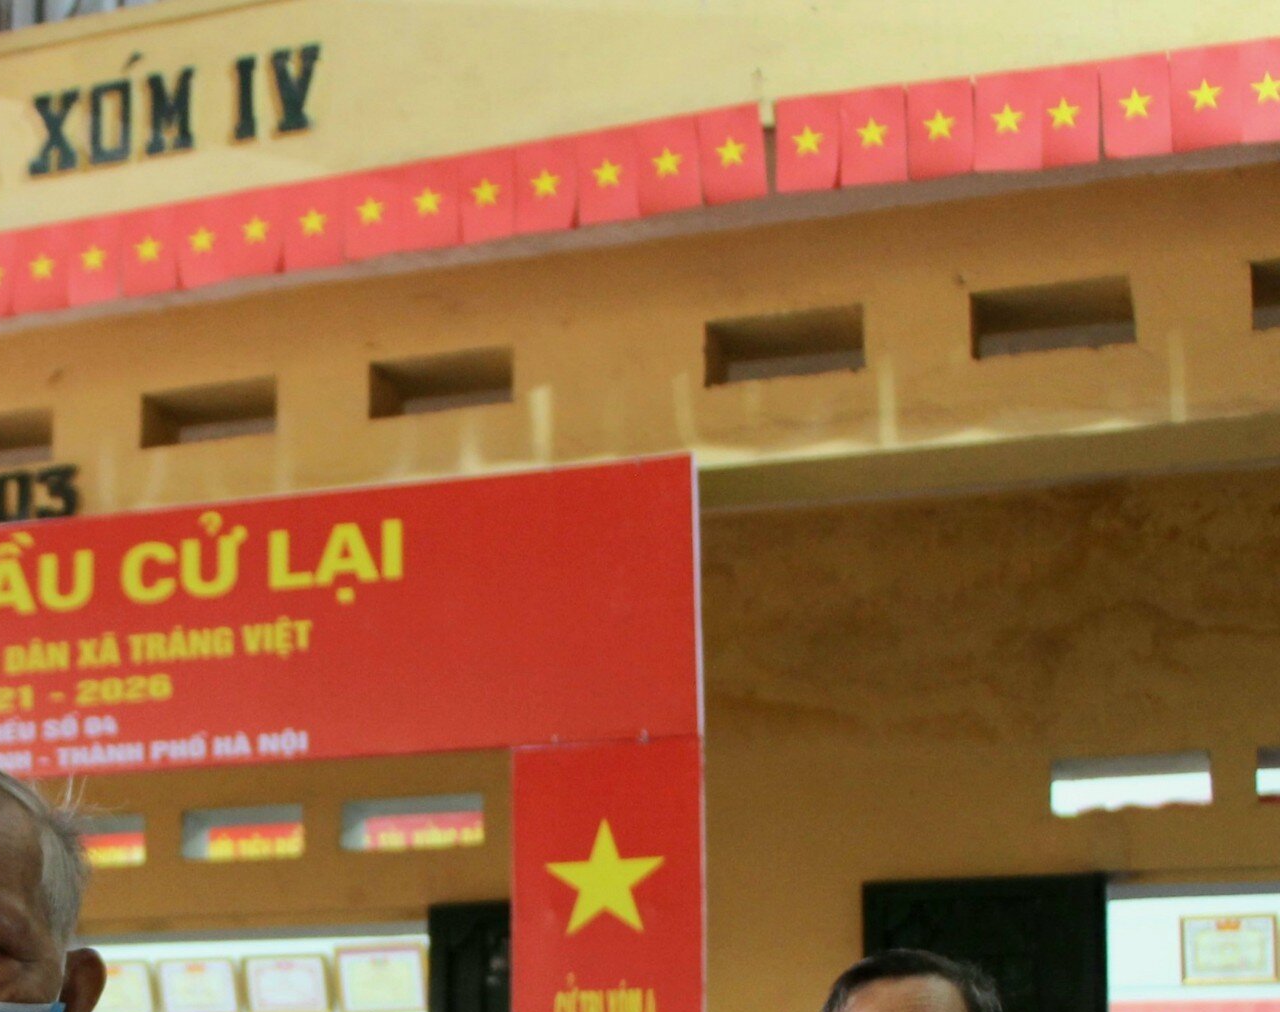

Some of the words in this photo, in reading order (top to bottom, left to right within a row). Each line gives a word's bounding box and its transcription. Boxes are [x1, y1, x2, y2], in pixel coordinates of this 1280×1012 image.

[28, 52, 195, 177] XÓM
[232, 43, 322, 141] IV
[121, 512, 247, 600] CỬ
[268, 519, 404, 603] LẠI
[4, 638, 69, 675] DÂN
[78, 631, 119, 668] XÃ
[129, 625, 234, 664] TRÁNG
[242, 616, 313, 658] VIỆT
[76, 674, 173, 706] 2026
[42, 710, 79, 740] SỐ
[57, 743, 144, 768] THÀNH
[150, 730, 208, 762] PHỐ
[212, 731, 253, 756] HÀ
[257, 727, 309, 758] NỘI
